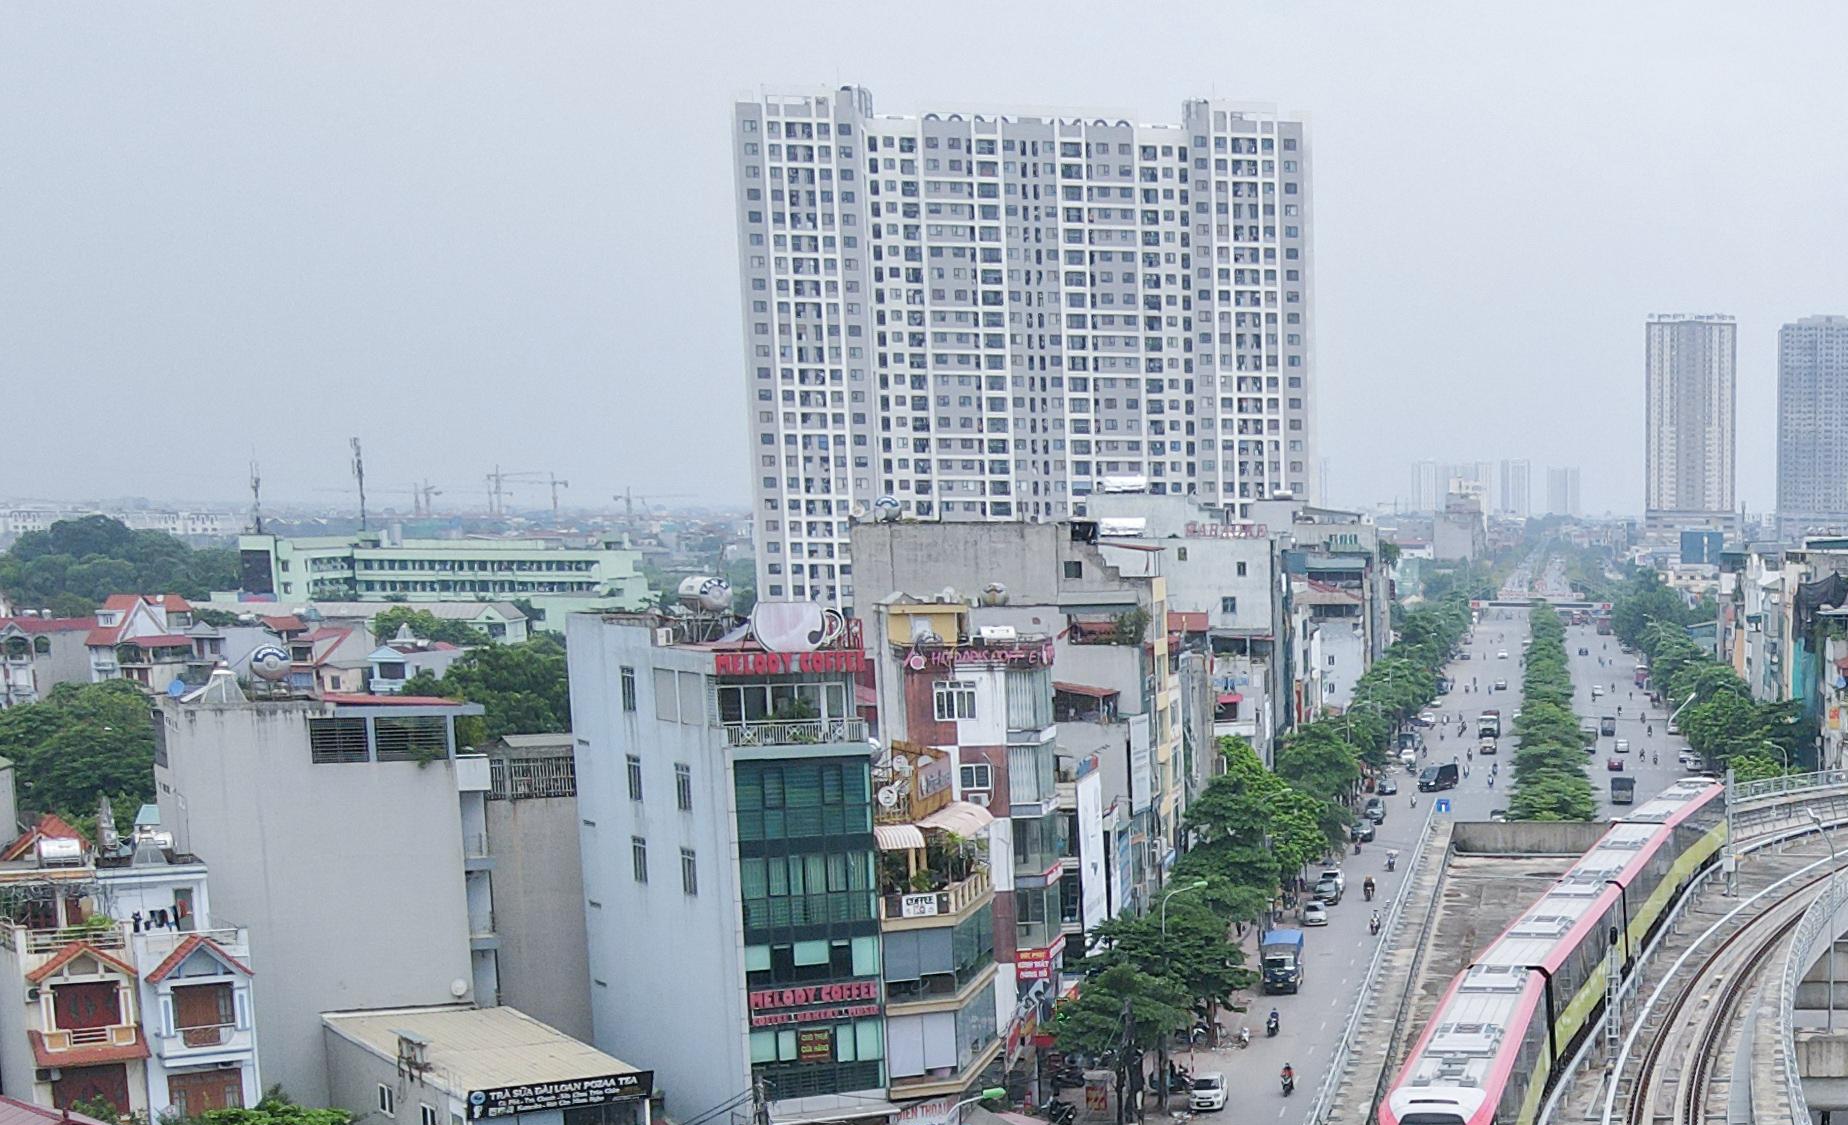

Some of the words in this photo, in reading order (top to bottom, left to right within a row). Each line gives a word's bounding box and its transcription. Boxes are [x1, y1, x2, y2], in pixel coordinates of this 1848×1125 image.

[715, 653, 792, 675] MELODY
[799, 651, 866, 673] COFFEE
[750, 987, 816, 1010] MELODY
[820, 980, 878, 1003] COFFEE
[555, 1082, 582, 1093] LOAN
[617, 1076, 638, 1086] TEA
